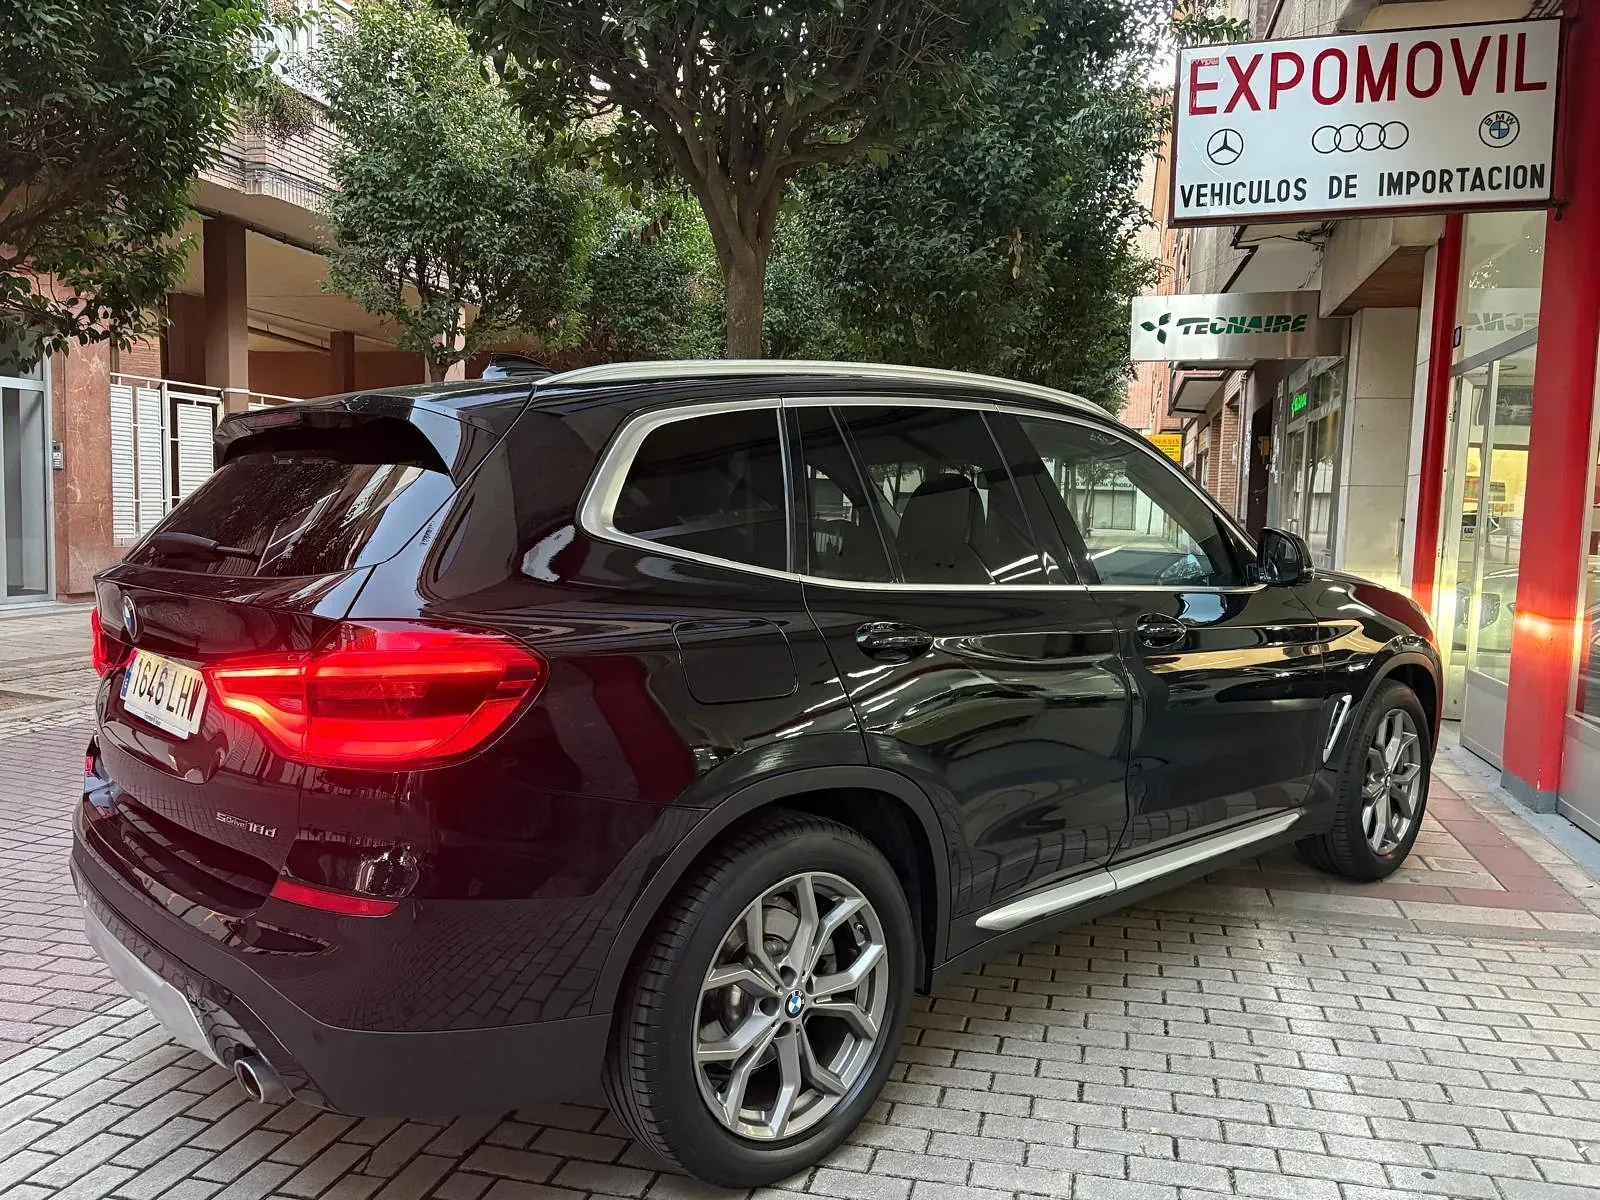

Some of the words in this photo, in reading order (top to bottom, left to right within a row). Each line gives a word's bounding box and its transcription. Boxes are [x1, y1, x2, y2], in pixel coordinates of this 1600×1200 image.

[1188, 33, 1547, 116] EXPOMOVIL
[1484, 113, 1516, 126] BMW
[1180, 177, 1307, 208] VEHICULOS
[1328, 174, 1358, 200] DE
[1378, 163, 1545, 197] IMPORTACION
[1176, 313, 1308, 335] TECNAIRE
[133, 658, 168, 706] 1646
[166, 671, 203, 722] LHW
